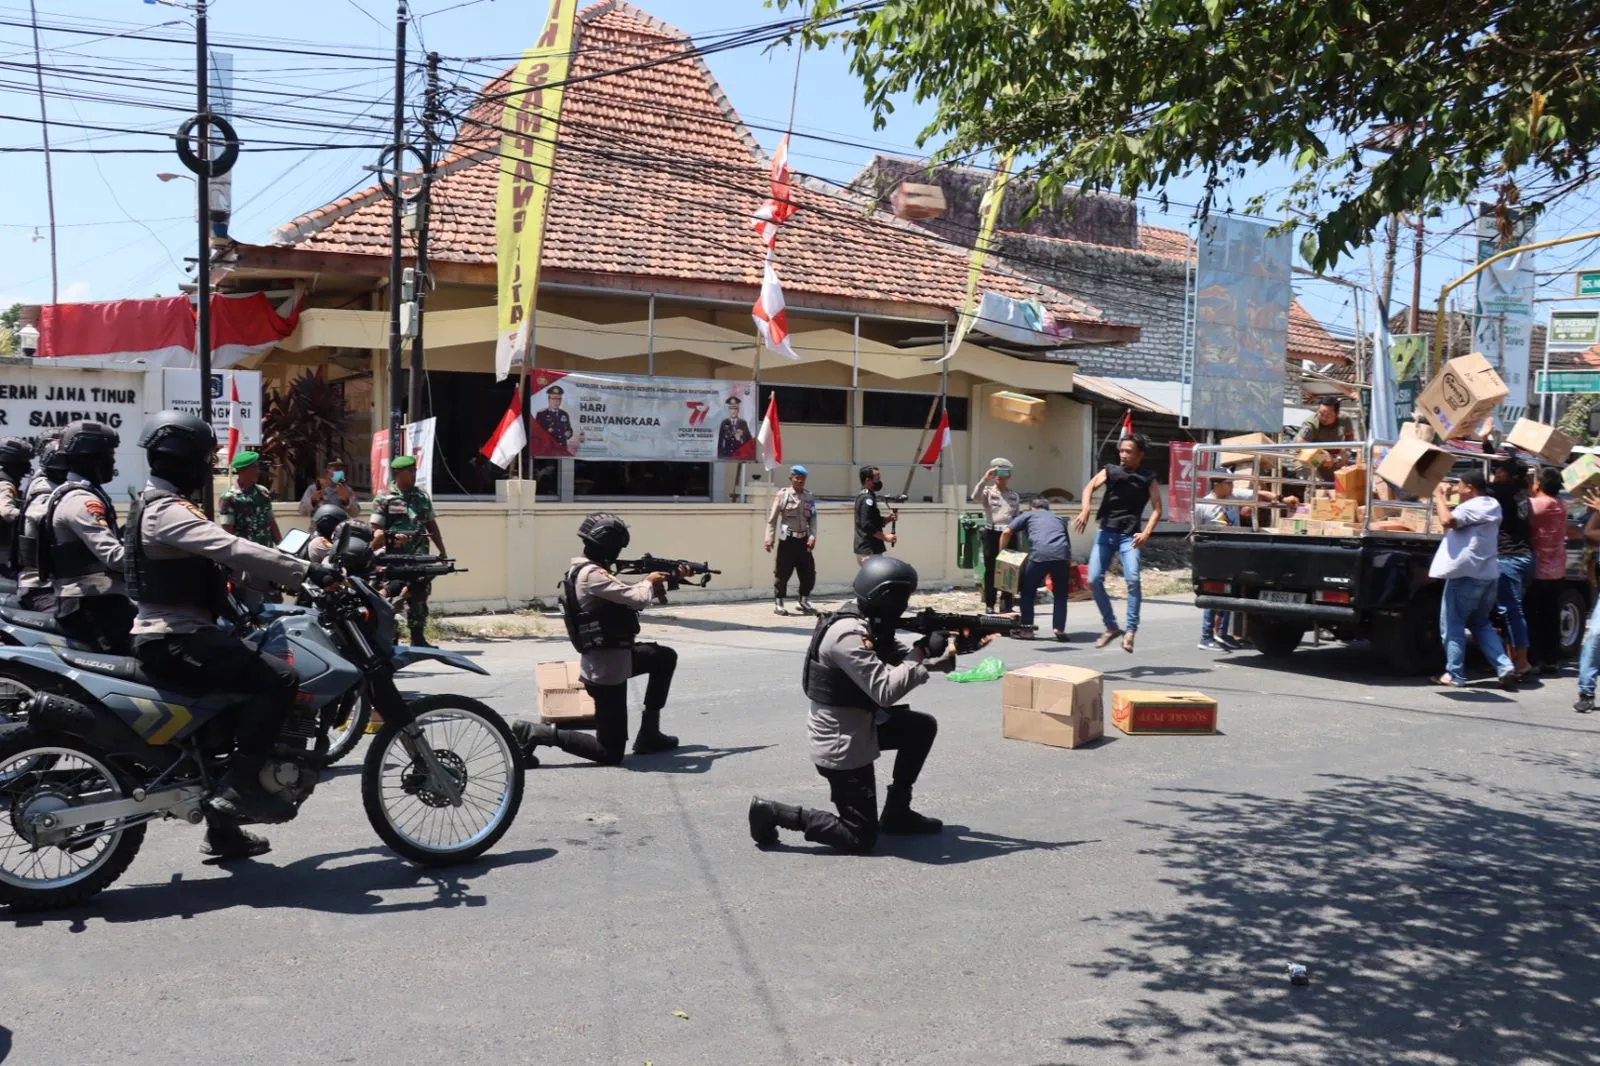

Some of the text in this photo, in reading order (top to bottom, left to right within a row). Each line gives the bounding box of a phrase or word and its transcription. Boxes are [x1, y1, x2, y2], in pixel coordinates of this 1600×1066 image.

[91, 387, 136, 404] TIMUR
[579, 402, 606, 412] HARI
[579, 414, 661, 427] BHAYANGKARA
